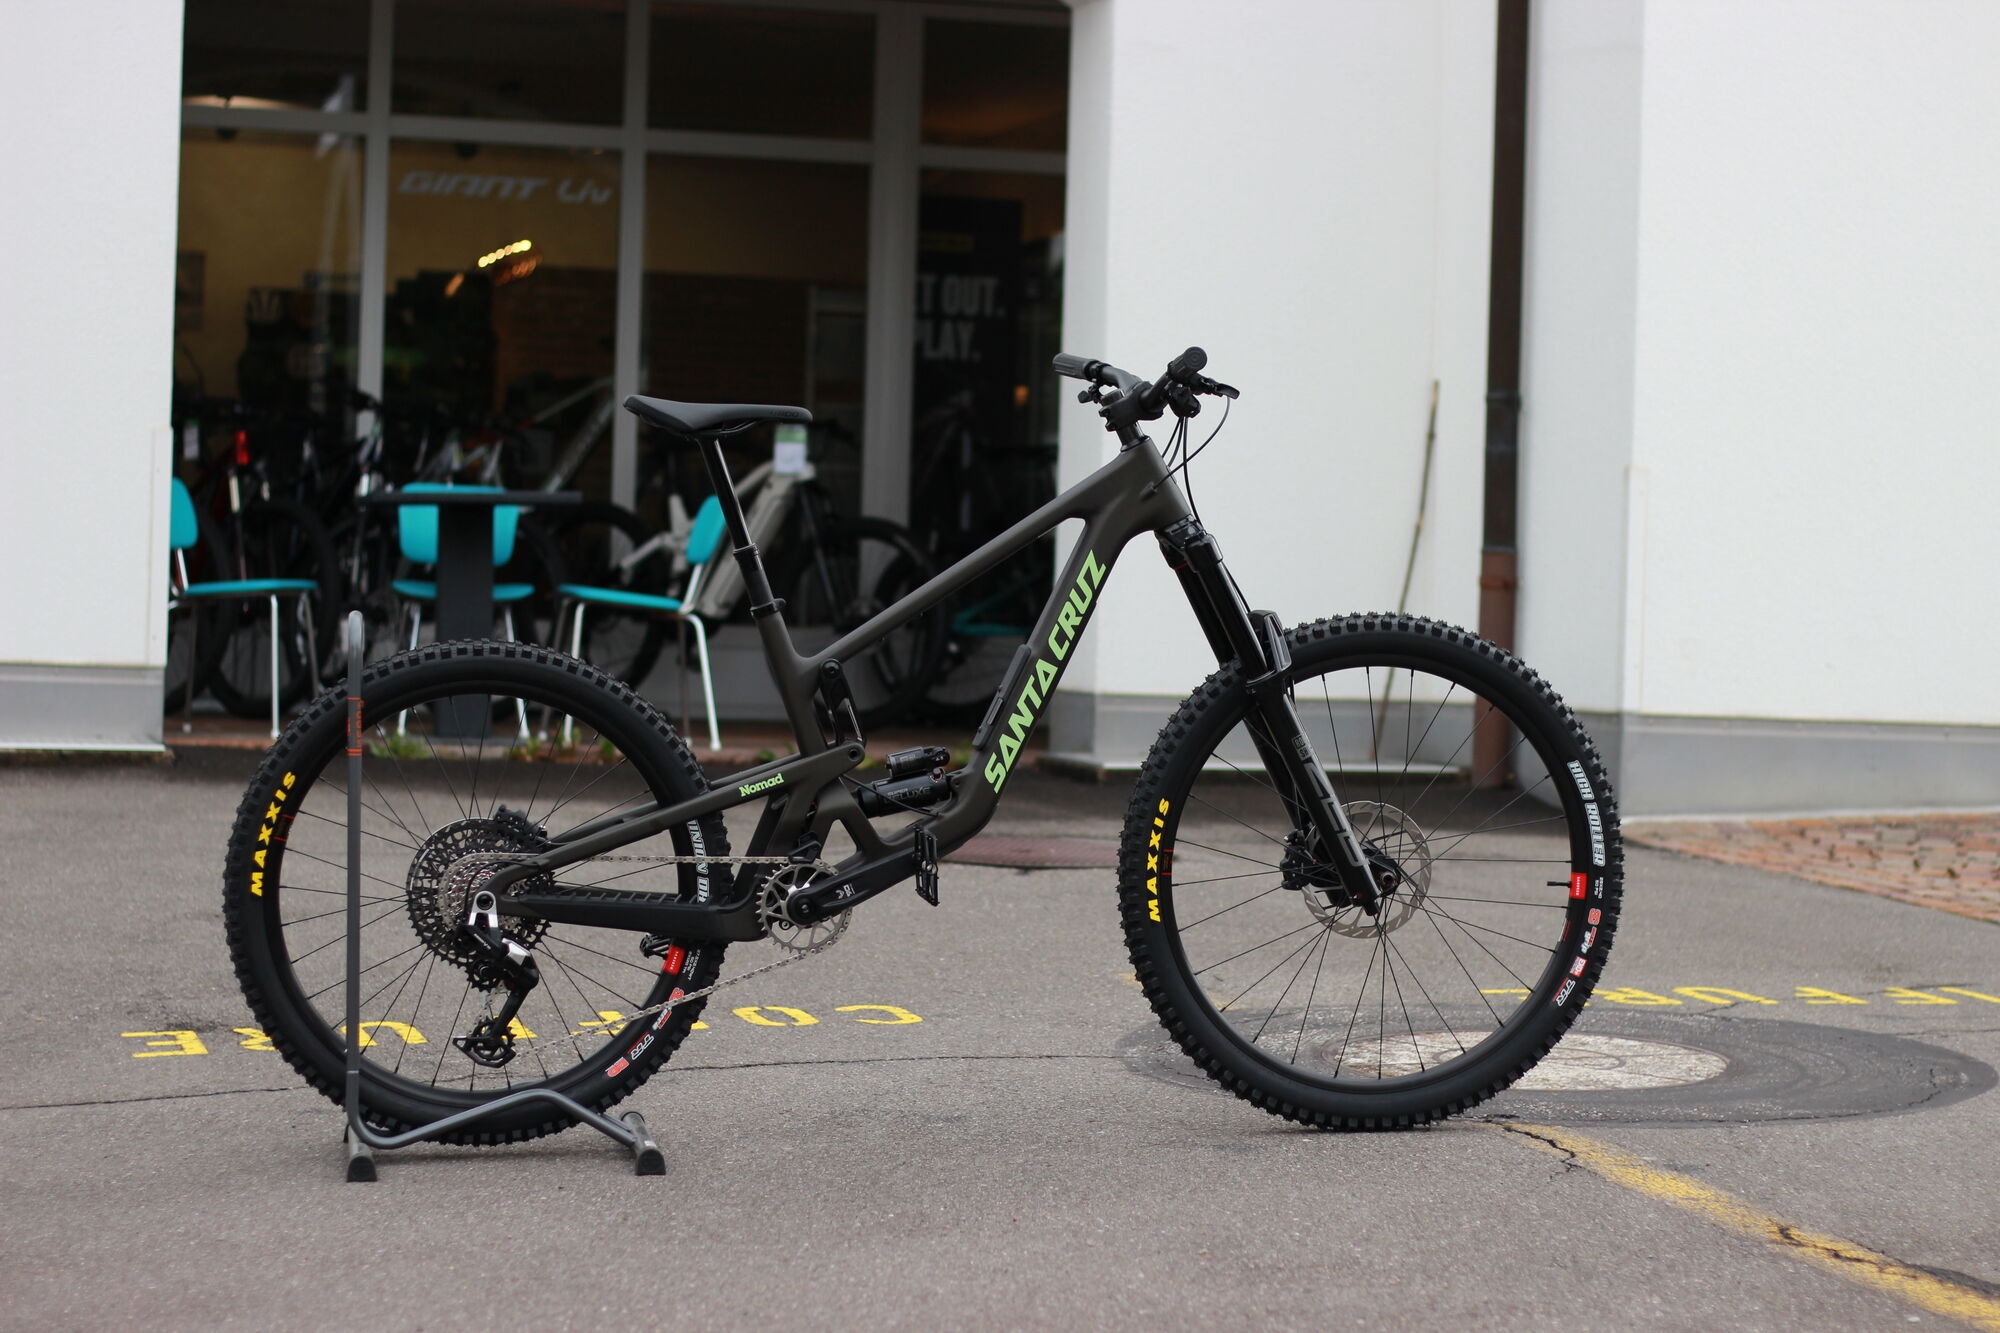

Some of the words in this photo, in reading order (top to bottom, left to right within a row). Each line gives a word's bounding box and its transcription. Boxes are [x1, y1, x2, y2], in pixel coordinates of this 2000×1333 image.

[398, 170, 548, 199] GIANT
[556, 178, 613, 204] Liv
[941, 274, 1006, 318] OUT.
[984, 658, 1059, 793] SANTA
[1048, 551, 1107, 661] CRUZ
[250, 771, 296, 897] MAXXIS
[739, 774, 785, 797] Nomad
[1566, 759, 1594, 801] HIGH
[1584, 801, 1607, 867] ROLLER
[1146, 799, 1170, 922] MAXXIS
